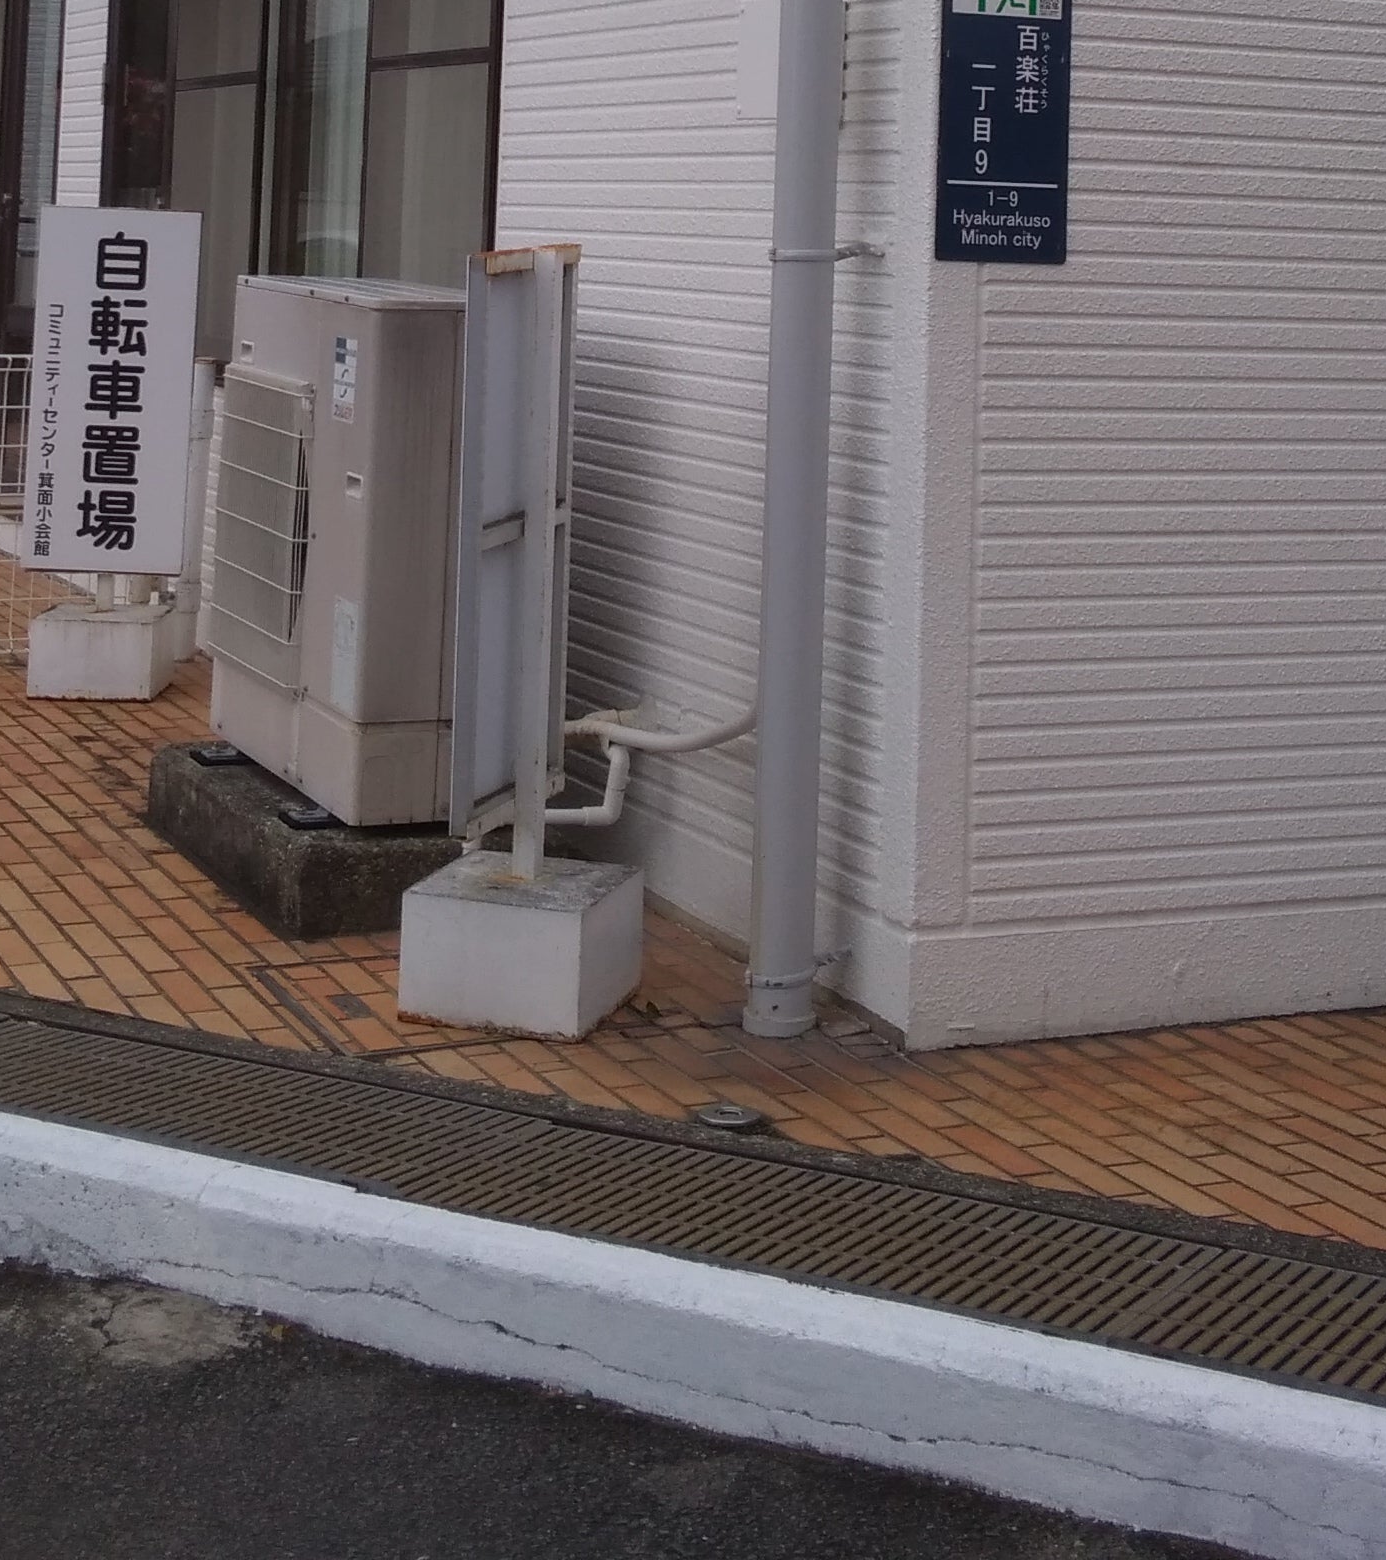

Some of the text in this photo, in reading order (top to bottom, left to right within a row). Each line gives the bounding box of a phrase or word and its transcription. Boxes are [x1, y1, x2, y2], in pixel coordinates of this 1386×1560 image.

[1014, 25, 1040, 114] 百楽荘
[1040, 31, 1051, 110] ひゃくらくそう
[953, 208, 1051, 228] Hyakurakuso
[961, 228, 1042, 250] Minoh city
[33, 303, 64, 556] コミュニティーセンター箕面小会館
[76, 231, 149, 551] 自転車置場
